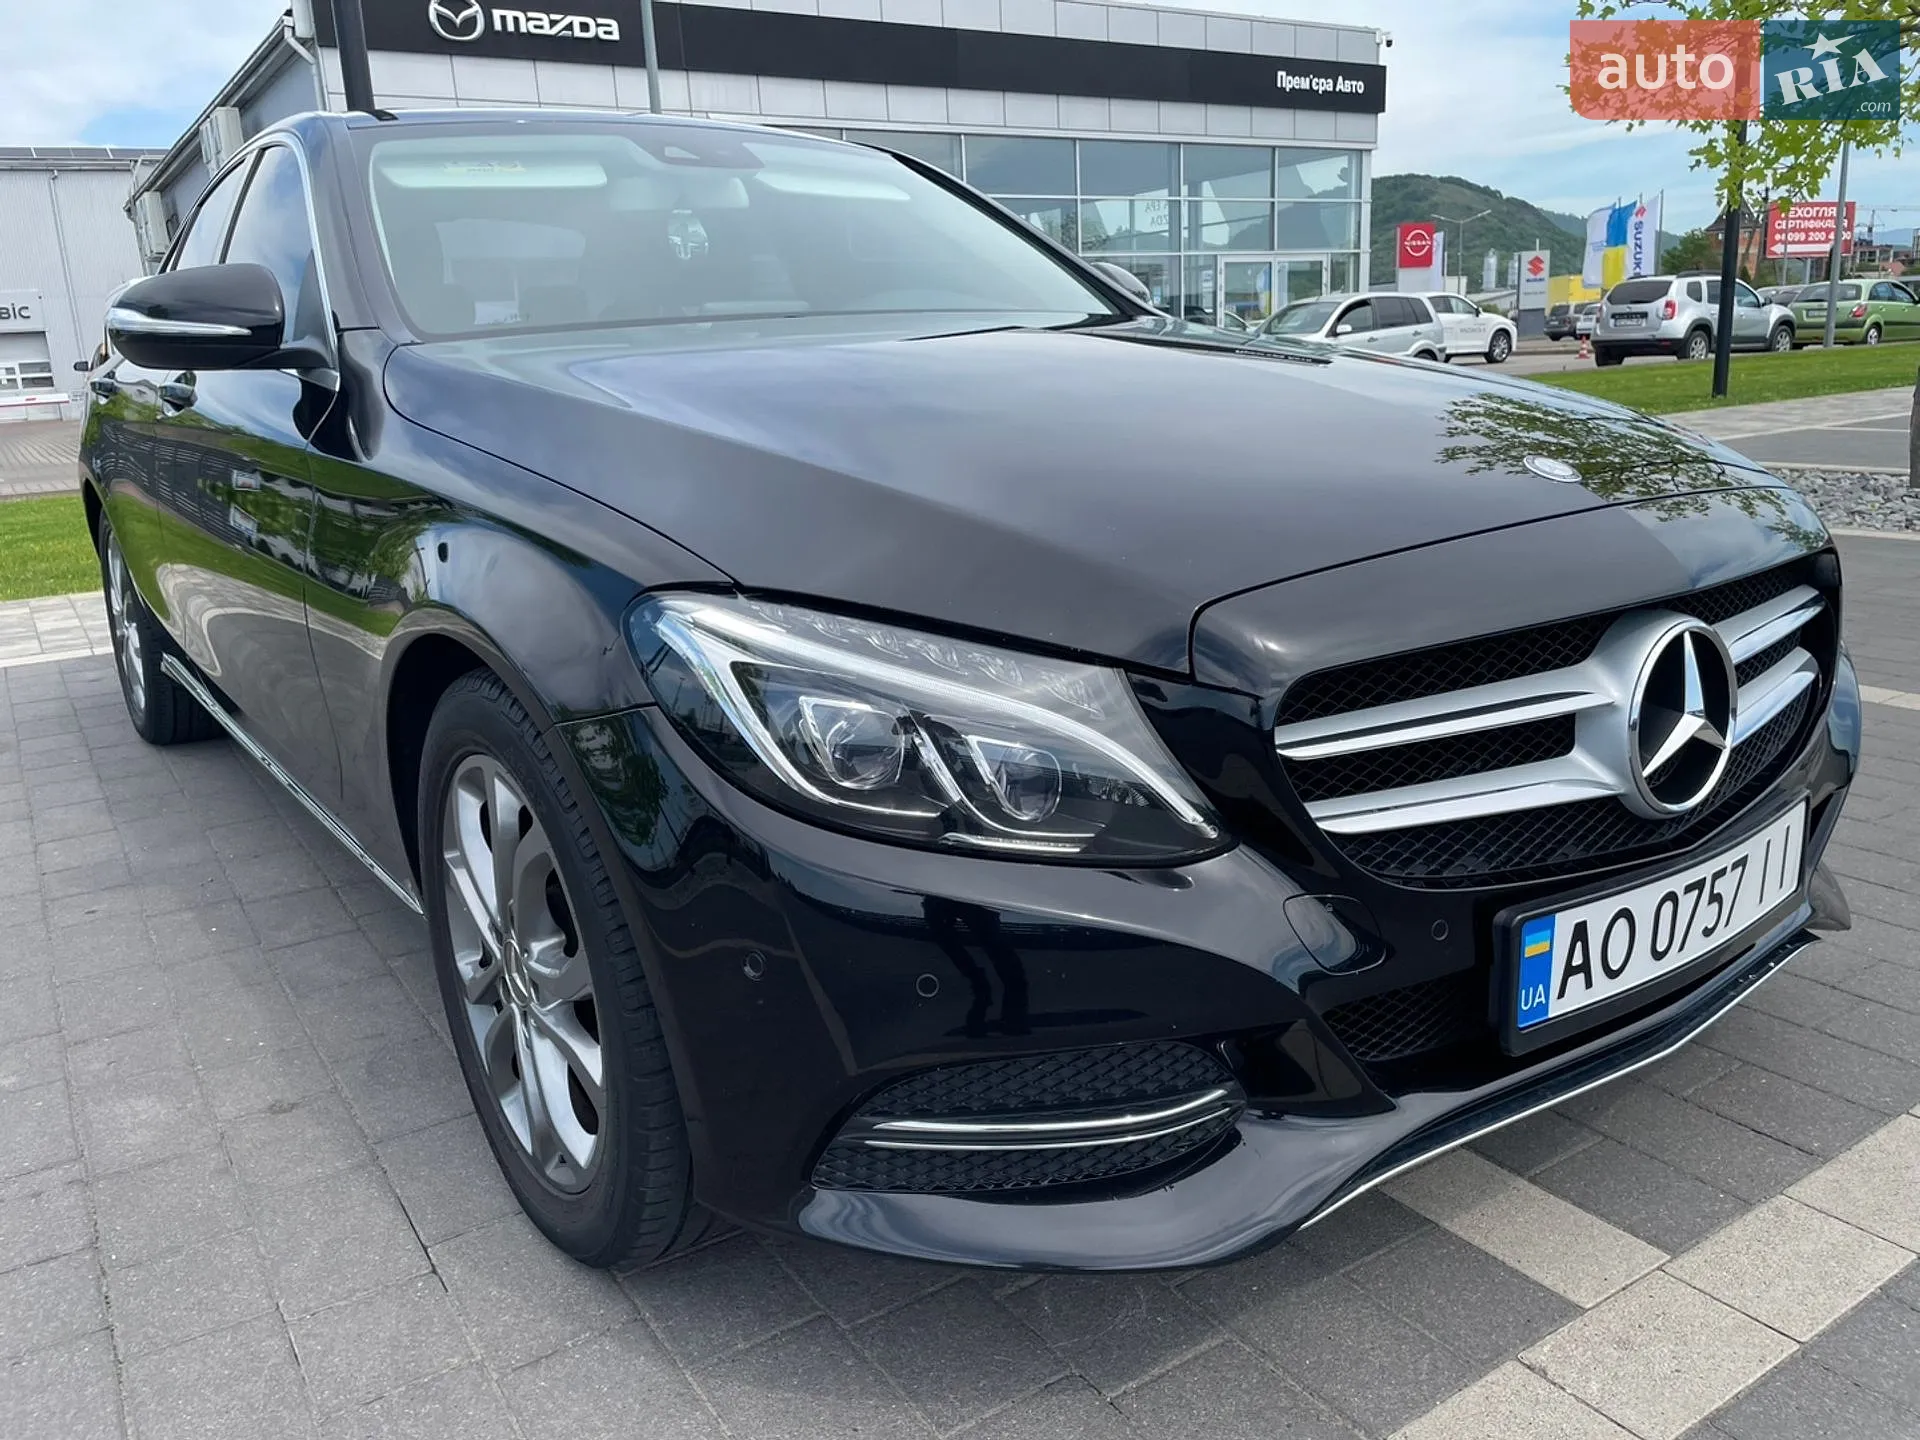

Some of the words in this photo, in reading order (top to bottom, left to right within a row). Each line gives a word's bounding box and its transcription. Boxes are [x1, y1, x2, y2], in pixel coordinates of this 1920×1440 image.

[1336, 75, 1365, 94] Авто
[1787, 231, 1806, 241] 099
[1808, 231, 1826, 241] 200
[1556, 907, 1637, 1000] AO
[1651, 853, 1749, 962] 0757
[1520, 984, 1546, 1011] UA
